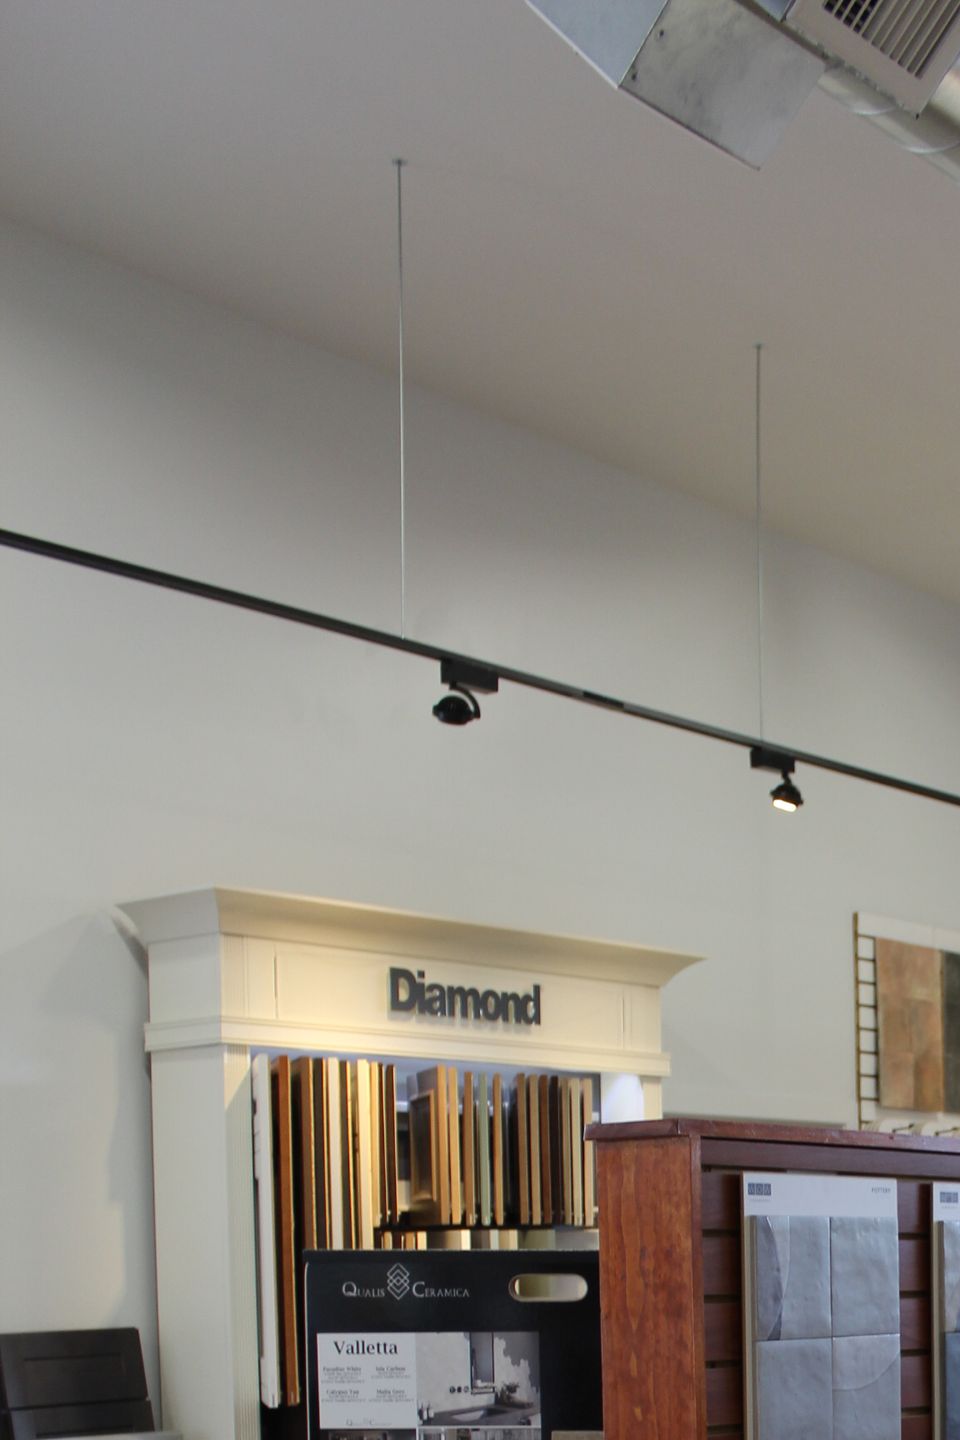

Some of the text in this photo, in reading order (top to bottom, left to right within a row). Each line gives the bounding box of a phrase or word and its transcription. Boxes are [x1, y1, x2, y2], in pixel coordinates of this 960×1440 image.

[389, 966, 541, 1026] Diamond
[341, 1280, 470, 1299] QUALIS CERAMICA
[333, 1340, 398, 1355] Valletta
